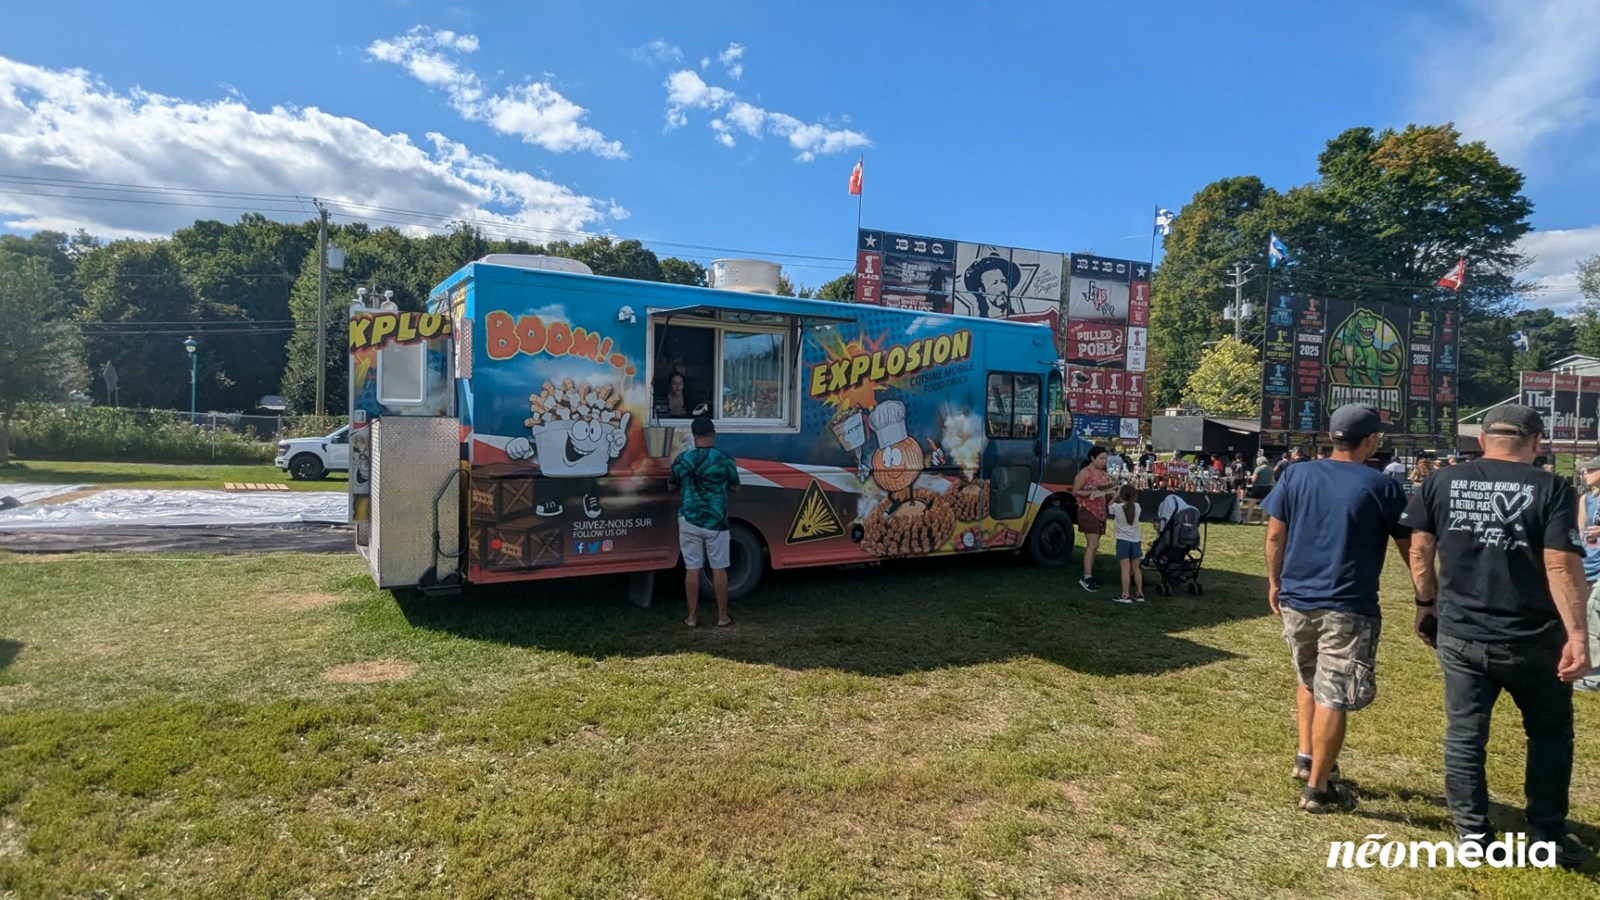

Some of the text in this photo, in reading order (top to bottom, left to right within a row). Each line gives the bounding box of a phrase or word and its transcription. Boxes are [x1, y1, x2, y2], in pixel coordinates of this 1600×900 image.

[895, 238, 945, 255] BBQ
[1076, 258, 1126, 274] RIBS
[1076, 330, 1112, 341] PULLED
[1077, 342, 1117, 357] PORK
[1299, 344, 1319, 356] 2025
[811, 331, 972, 397] EXPLOSION
[1412, 353, 1429, 365] 2025
[909, 361, 975, 387] CUISINE MOBILE
[923, 374, 969, 394] FOOD TRUCK
[1329, 386, 1400, 413] DINOSAUR
[1526, 390, 1552, 407] The
[1537, 410, 1594, 430] gfather
[1451, 479, 1535, 494] DEAR PERSON BEHIND ME
[1450, 490, 1490, 500] THE WORLD IS
[1455, 499, 1476, 511] BETTER
[1476, 501, 1492, 511] PLACE
[1468, 512, 1481, 520] YOU
[1482, 513, 1490, 521] IN
[1491, 513, 1496, 521] IT
[573, 518, 652, 531] SUIVEZ-NOUS SUR
[573, 529, 604, 538] FOLLOW
[604, 529, 615, 537] US
